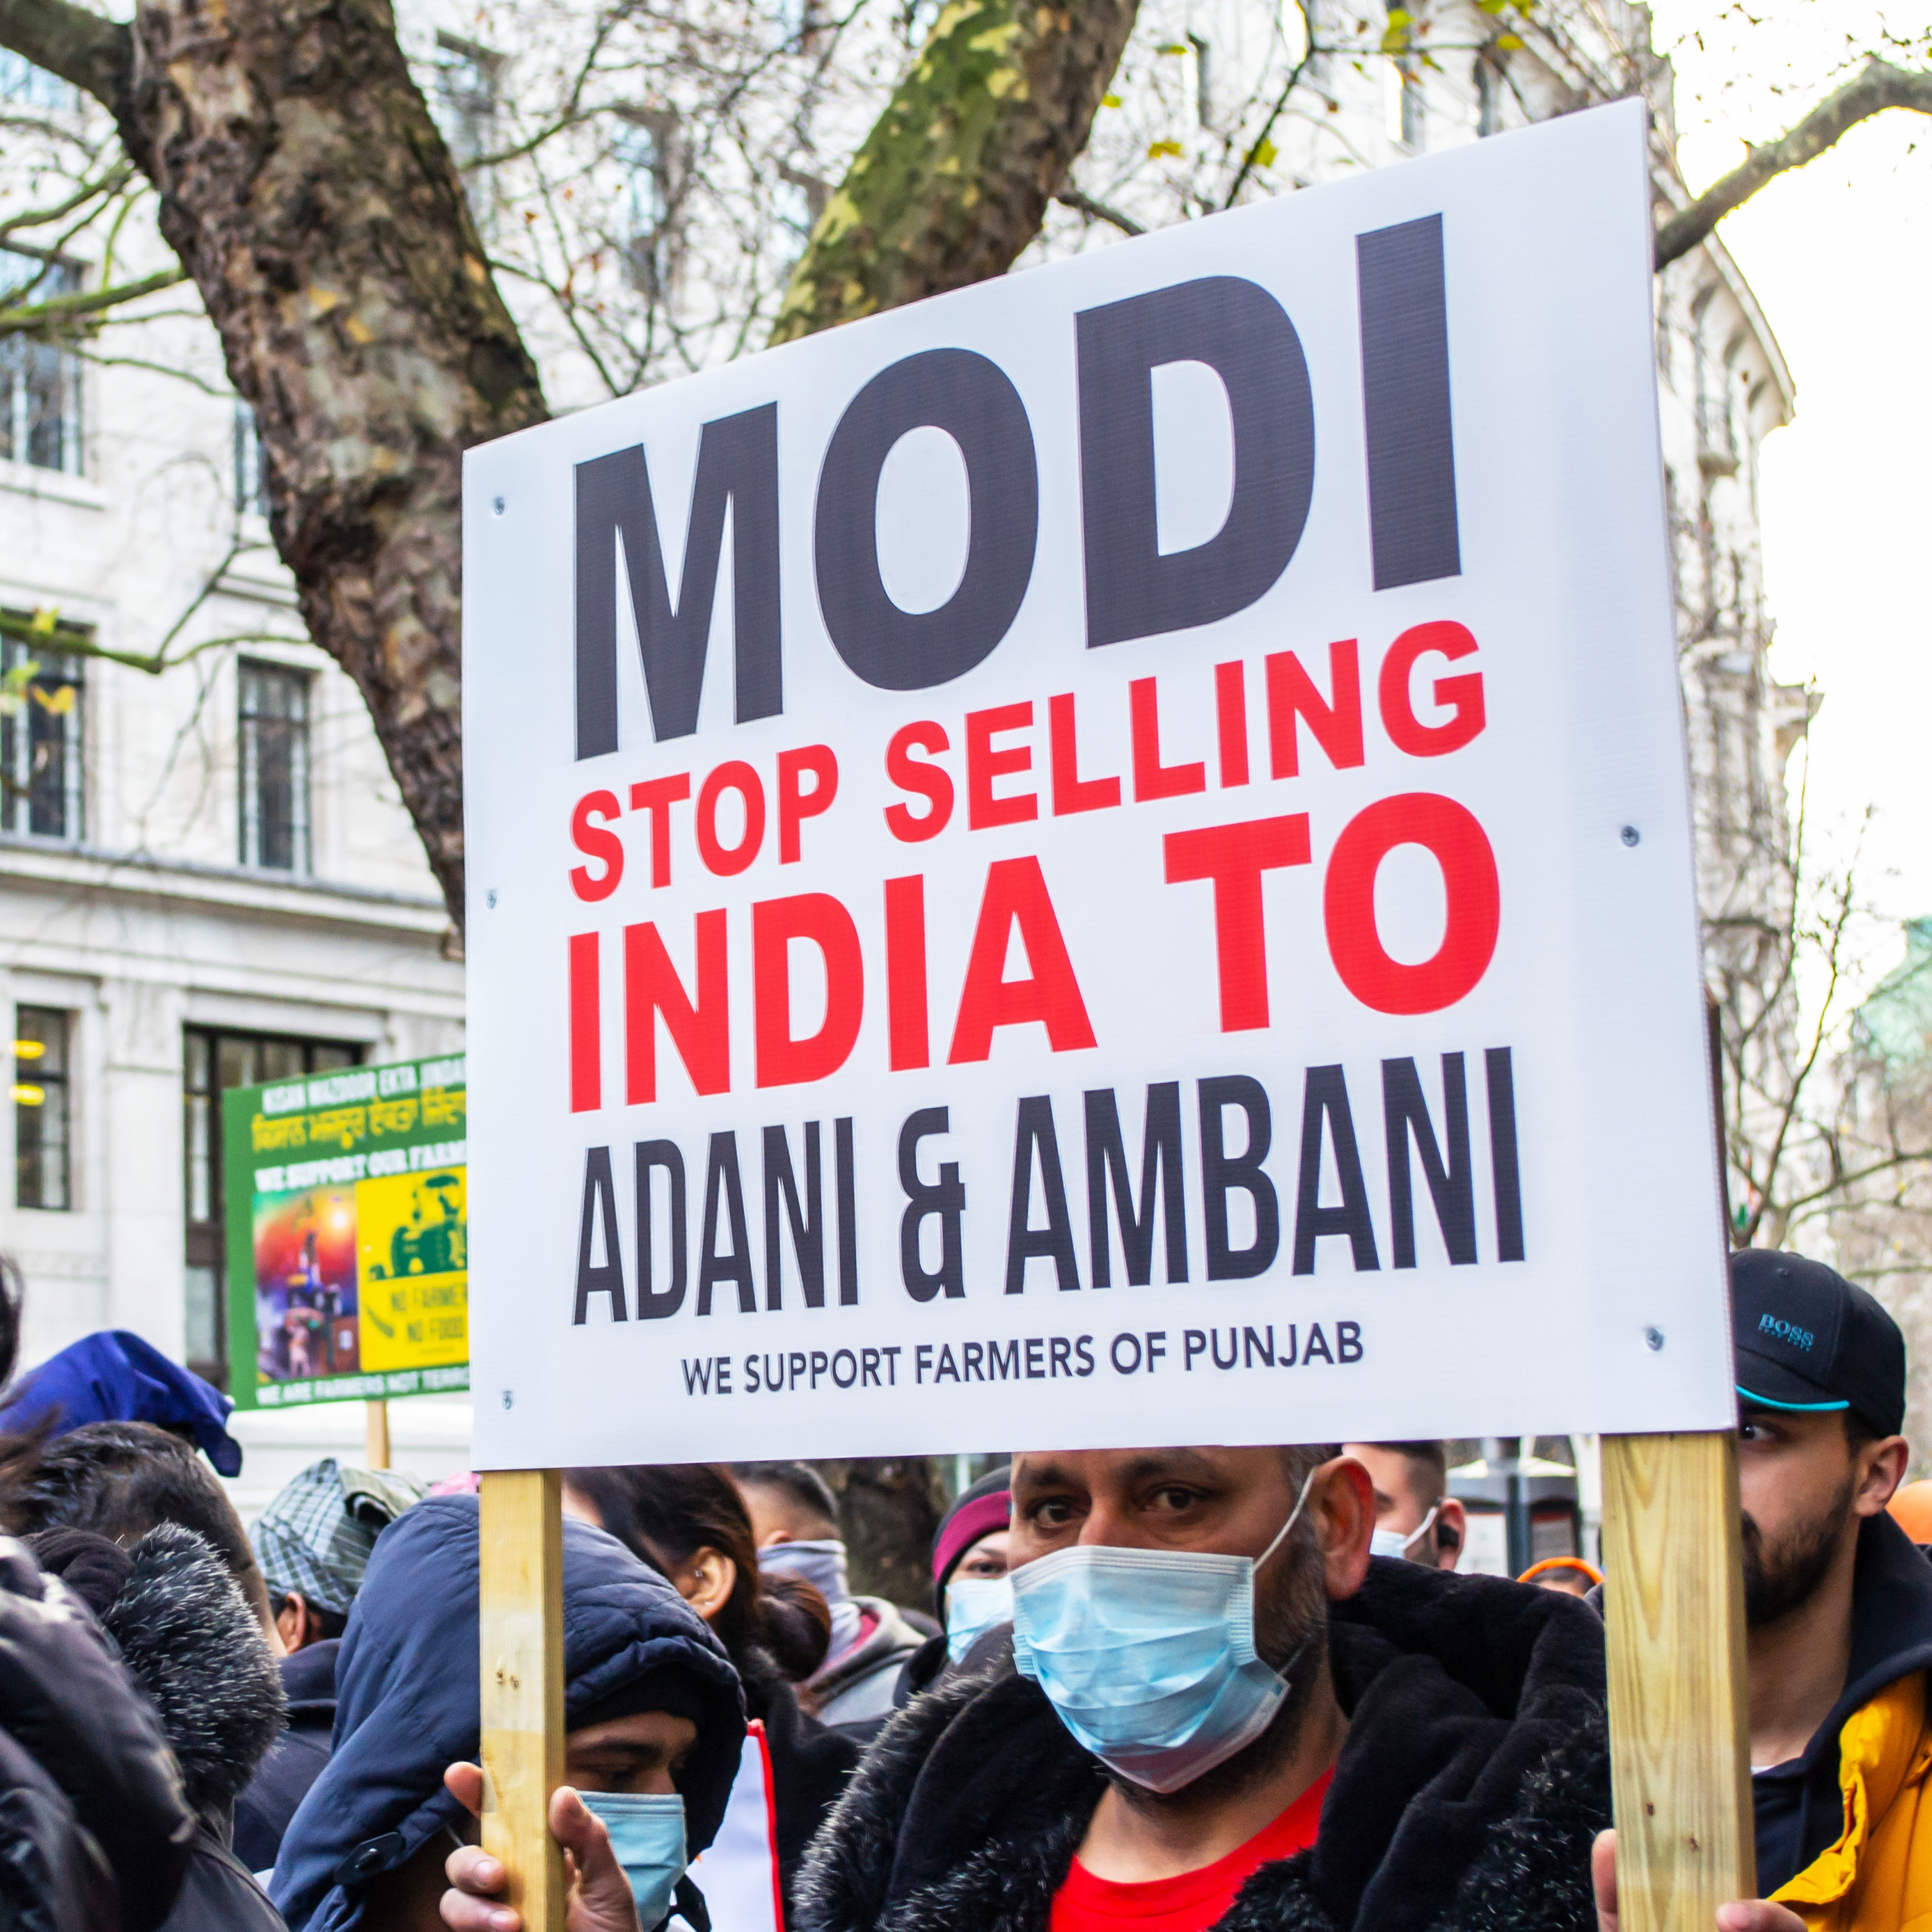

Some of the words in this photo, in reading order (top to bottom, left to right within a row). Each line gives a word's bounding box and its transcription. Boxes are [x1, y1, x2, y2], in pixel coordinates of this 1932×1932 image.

[575, 212, 1462, 761] MODI
[570, 744, 839, 903] STOP
[885, 620, 1486, 843] SELLING
[569, 855, 1098, 1113] INDIA
[1163, 792, 1501, 1033] TO
[255, 1166, 284, 1192] WE
[286, 1154, 367, 1189] SUPPORT
[367, 1148, 407, 1176] OUR
[573, 1116, 859, 1326] ADANI
[898, 1105, 966, 1303] &
[1005, 1046, 1526, 1295] AMBANI
[683, 1356, 733, 1396] WE
[745, 1347, 902, 1394] SUPPORT
[915, 1334, 1095, 1384] FARMERS
[1110, 1331, 1167, 1375] OF
[1183, 1321, 1364, 1371] PUNJAB
[1759, 1313, 1815, 1348] BOSS
